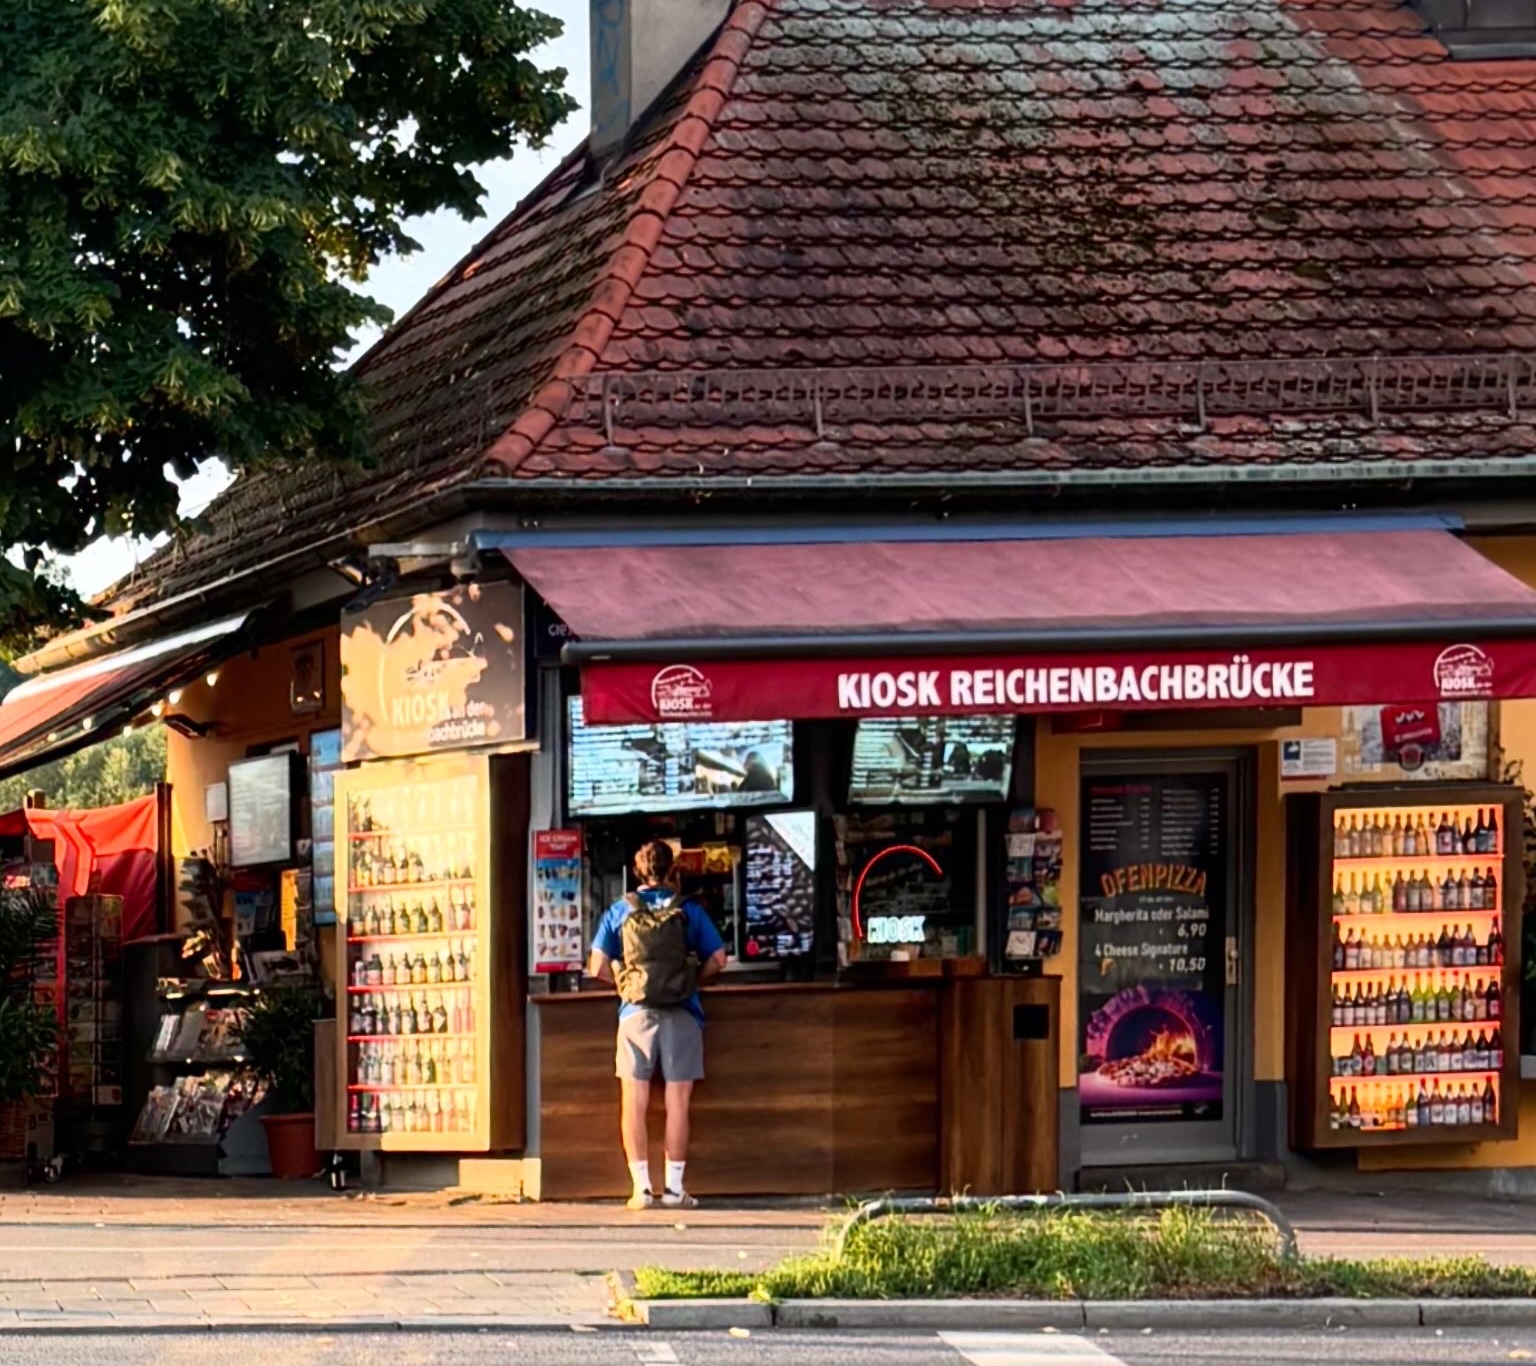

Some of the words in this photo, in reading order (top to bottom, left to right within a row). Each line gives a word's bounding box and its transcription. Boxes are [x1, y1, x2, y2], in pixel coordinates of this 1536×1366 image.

[838, 669, 942, 709] KIOSK
[949, 654, 1314, 706] REICHENBACHBRÜCKE
[391, 690, 451, 727] KIOSK
[1100, 862, 1208, 898] OFENPIZZA
[1094, 908, 1149, 925] Margherita
[1151, 907, 1173, 922] oder
[1175, 904, 1210, 920] Salami
[867, 913, 926, 944] KIOSK
[1177, 922, 1208, 938] 6,90
[1103, 942, 1139, 957] Cheese
[1141, 941, 1189, 960] Signature
[1168, 956, 1207, 973] 10,50
